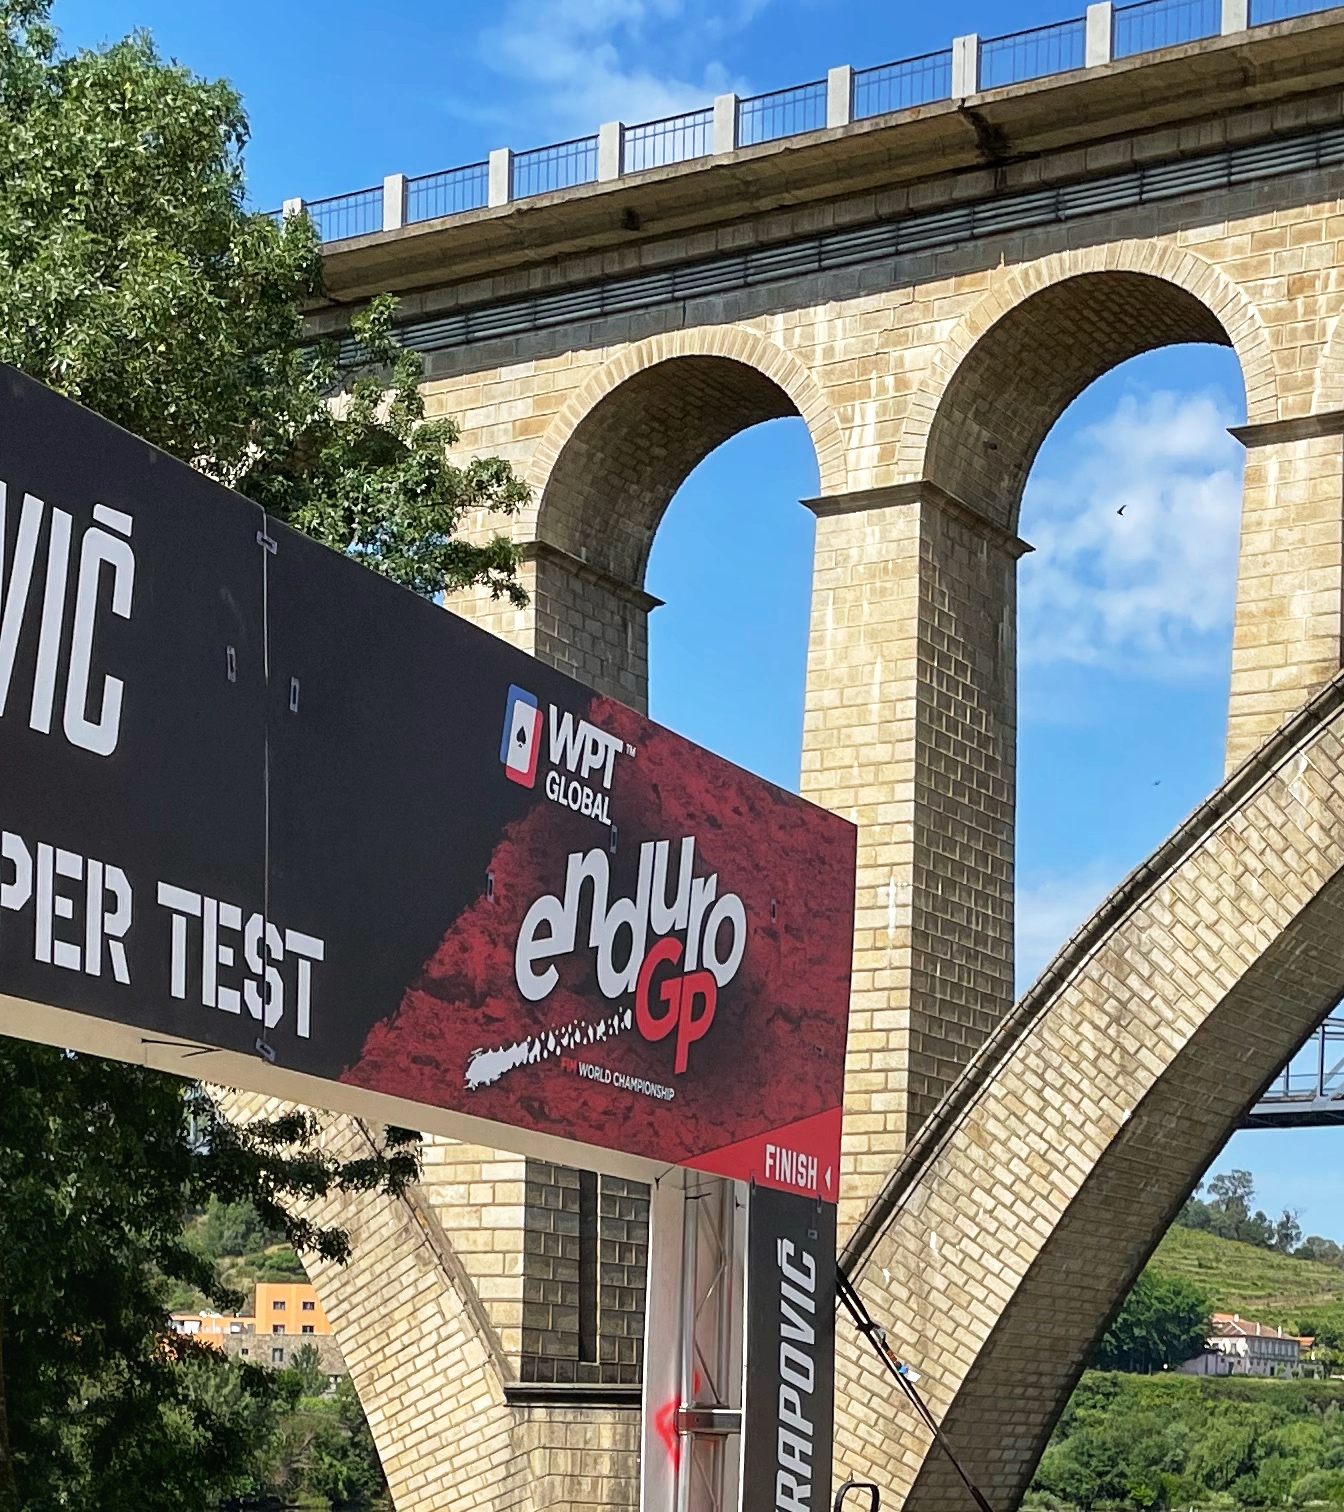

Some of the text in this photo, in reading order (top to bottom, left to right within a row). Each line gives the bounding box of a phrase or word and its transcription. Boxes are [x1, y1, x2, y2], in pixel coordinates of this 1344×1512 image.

[549, 703, 624, 789] WPT
[545, 770, 612, 826] GLOBAL
[157, 880, 325, 1039] TEST
[515, 835, 747, 1002] enduro
[635, 936, 718, 1076] GP
[578, 1061, 612, 1084] WORLD
[612, 1071, 675, 1101] CHAMPIONSHIP
[764, 1144, 819, 1191] FINISH
